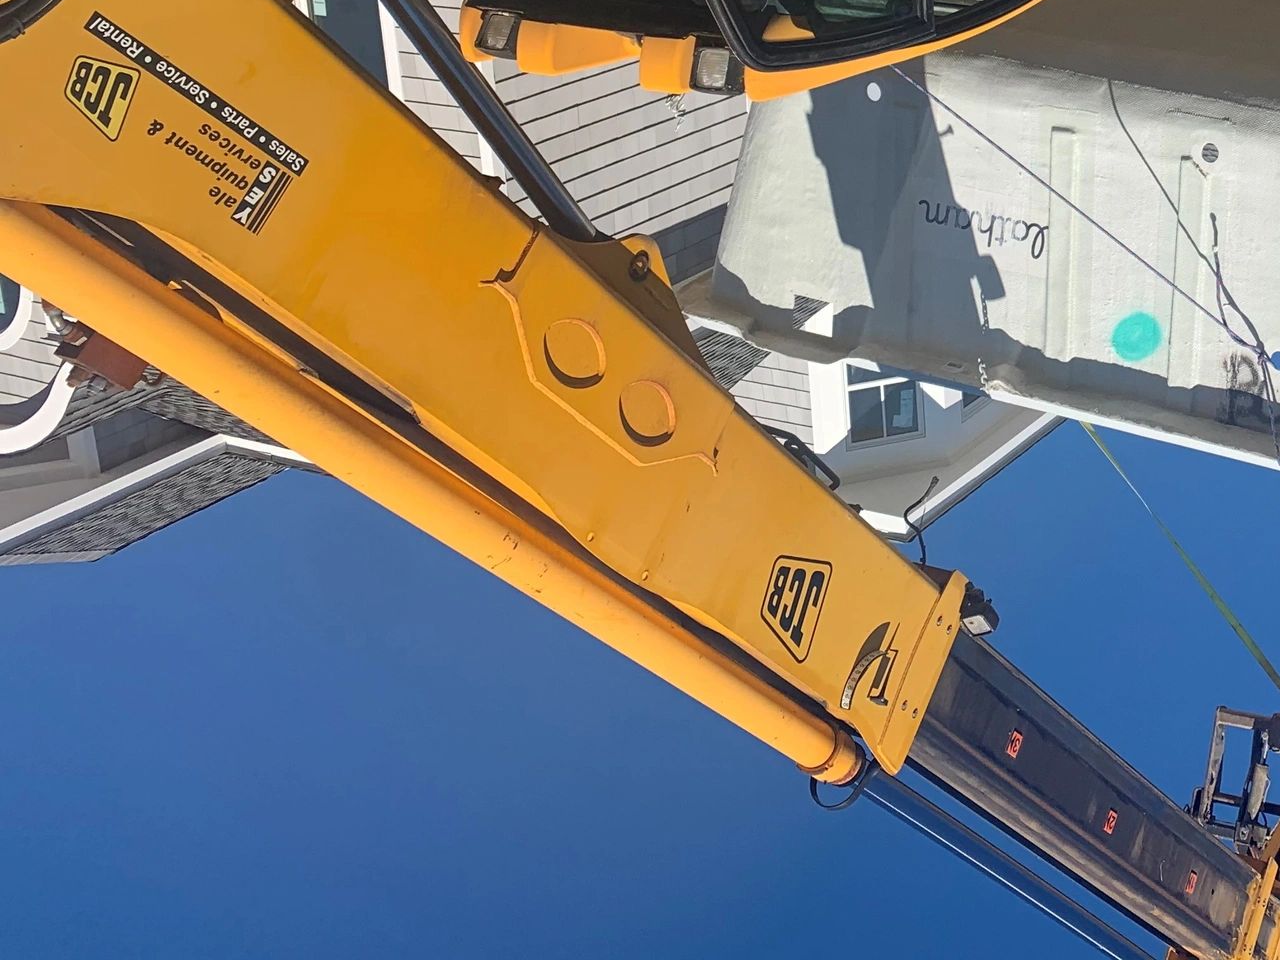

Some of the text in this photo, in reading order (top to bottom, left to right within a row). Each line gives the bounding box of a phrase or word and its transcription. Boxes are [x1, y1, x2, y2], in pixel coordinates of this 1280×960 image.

[70, 62, 134, 128] JCB
[88, 17, 305, 171] Sales Parts Service Rental
[145, 118, 165, 136] &
[918, 199, 1049, 260] latham
[766, 566, 825, 648] JCB
